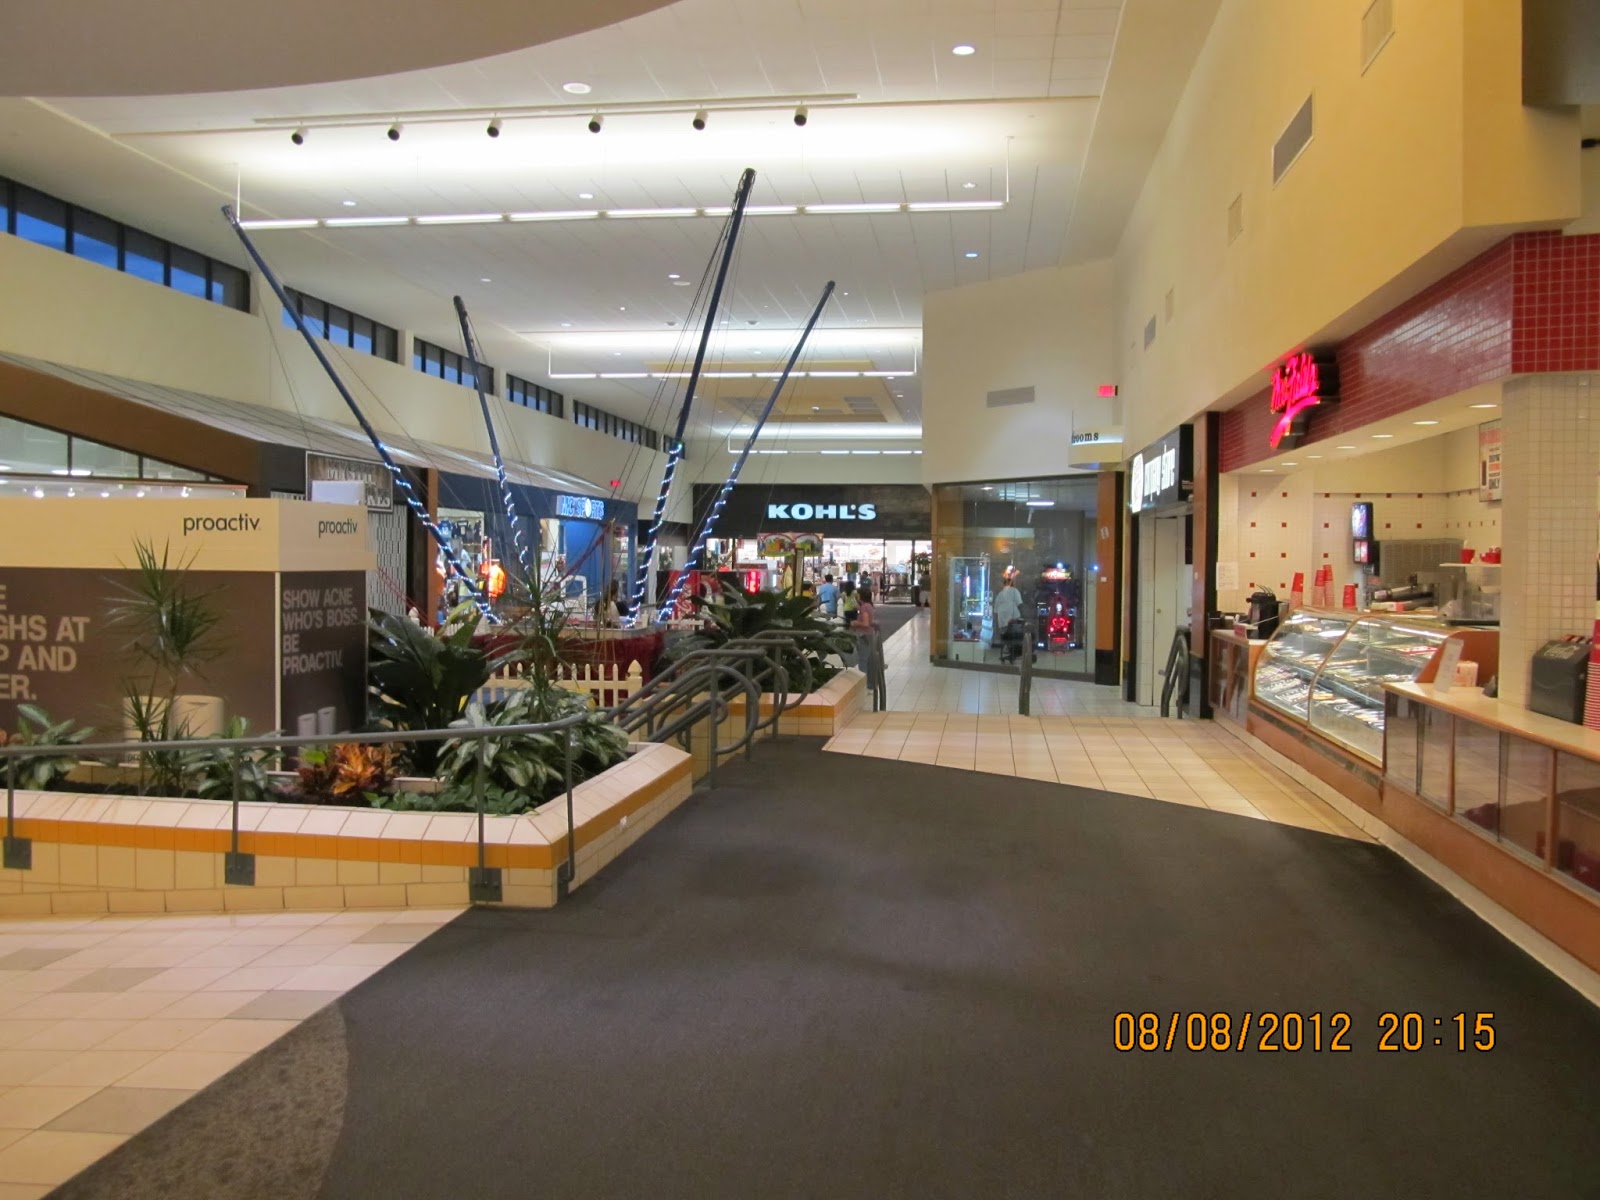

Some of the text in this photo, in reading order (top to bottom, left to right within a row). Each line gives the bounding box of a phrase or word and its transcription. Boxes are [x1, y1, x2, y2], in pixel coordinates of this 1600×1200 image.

[768, 503, 877, 520] KOHL'S
[183, 513, 260, 536] proactiv
[318, 518, 358, 538] proactiv
[283, 587, 353, 609] SHOW ACNE
[56, 616, 90, 643] AT
[283, 609, 324, 631] WHO'S
[283, 633, 300, 653] BE
[18, 644, 77, 672] AND
